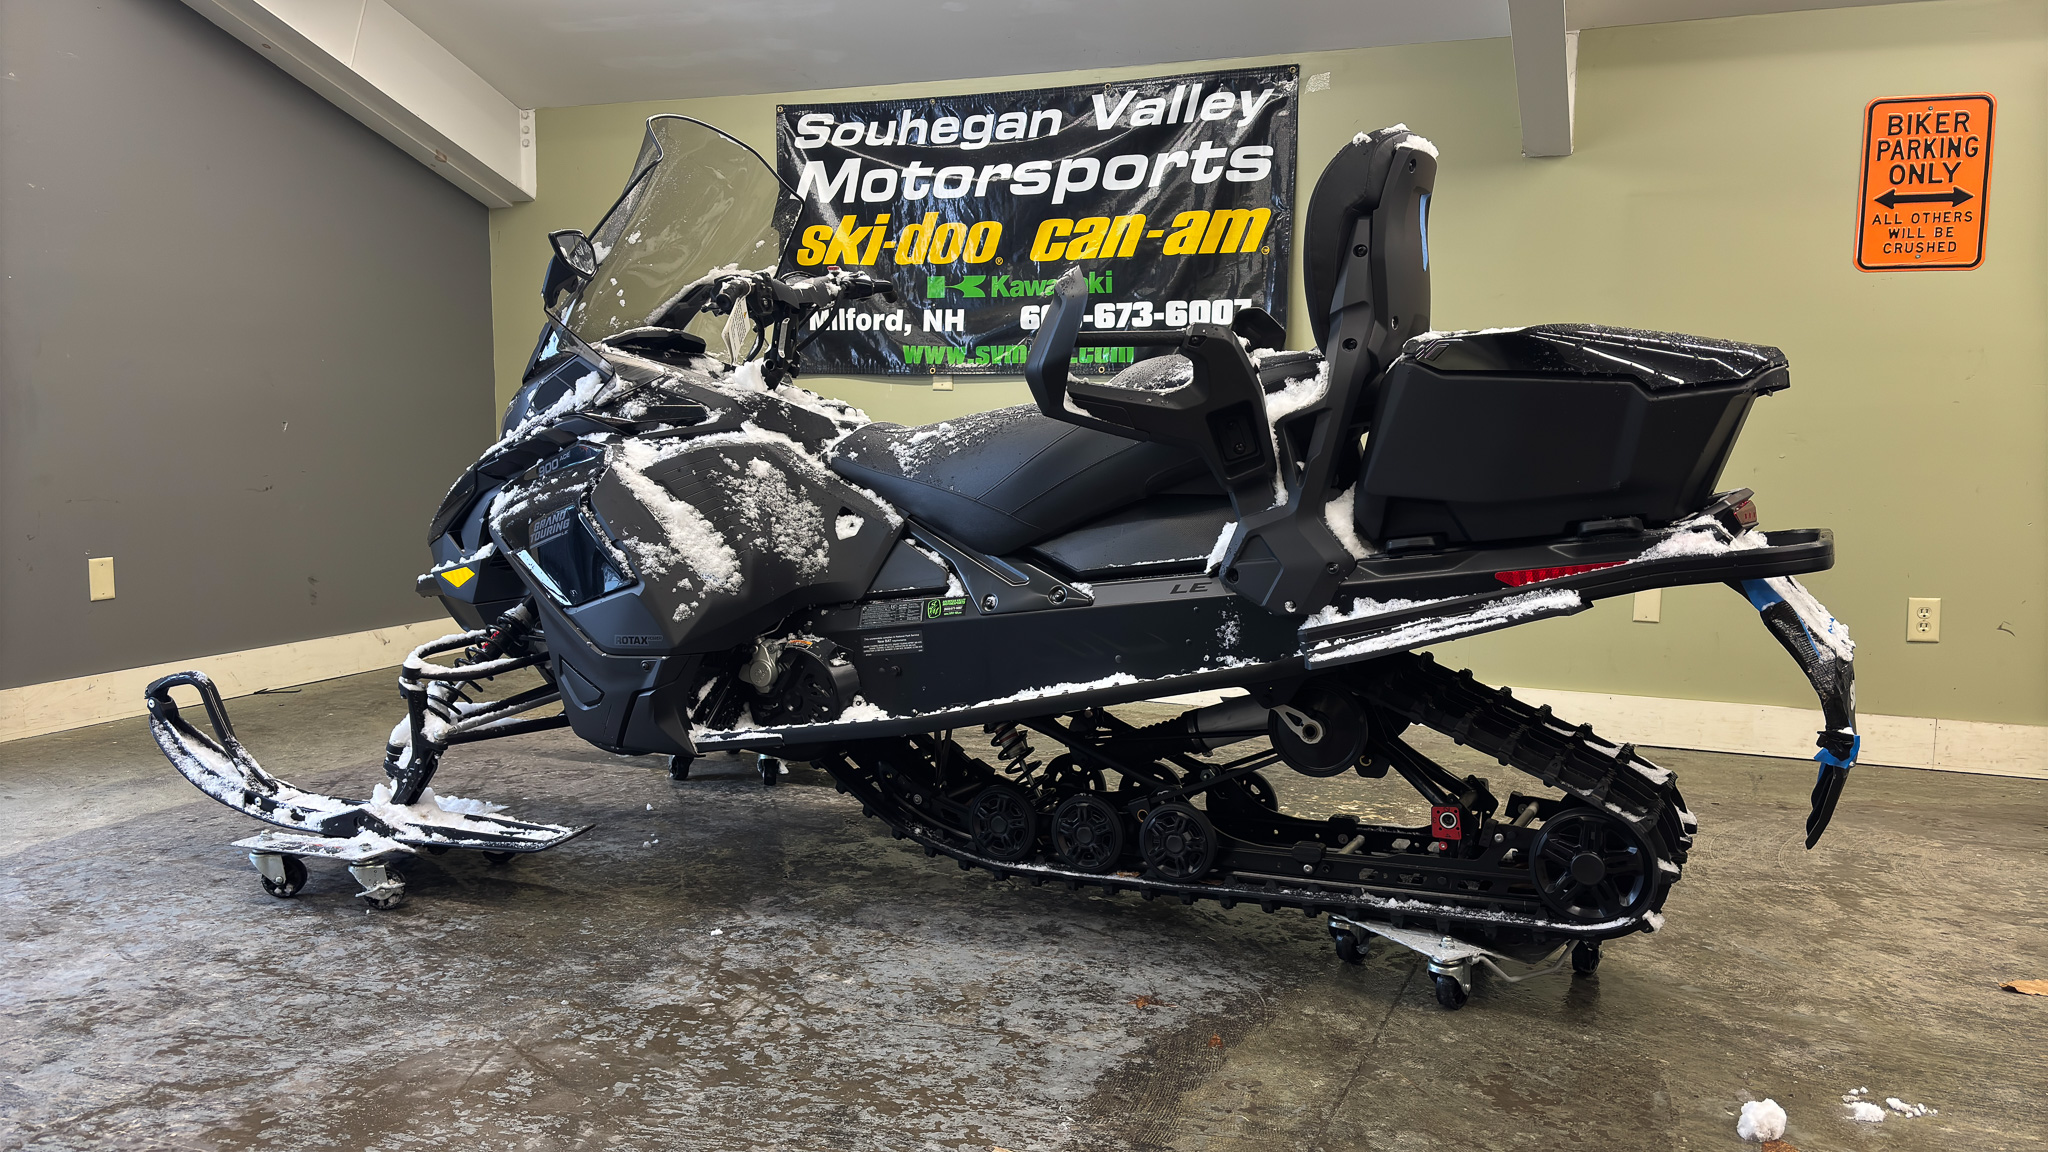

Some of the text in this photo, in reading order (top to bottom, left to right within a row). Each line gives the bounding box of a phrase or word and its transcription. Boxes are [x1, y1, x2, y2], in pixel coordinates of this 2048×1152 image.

[794, 83, 1276, 150] Souhegan Valley
[1887, 112, 1970, 136] BIKER
[1876, 136, 1979, 161] PARKING
[790, 140, 1274, 205] Motorsports
[1889, 162, 1961, 185] ONLY
[1872, 211, 1973, 225] ALL OTHERS
[797, 207, 1272, 266] ski-doo can-am
[1888, 226, 1954, 239] WILL BE
[1883, 241, 1957, 254] CRUSHED
[991, 270, 1113, 298] Kawaki
[809, 308, 965, 337] Milford, NH
[1020, 298, 1252, 330] 6-673-6007
[903, 344, 1134, 365] www.svm.com
[538, 450, 571, 478] 900 ACE
[530, 518, 570, 544] TOURING
[534, 510, 567, 532] GRAND
[1170, 581, 1213, 595] LE
[615, 636, 648, 645] ROTAX
